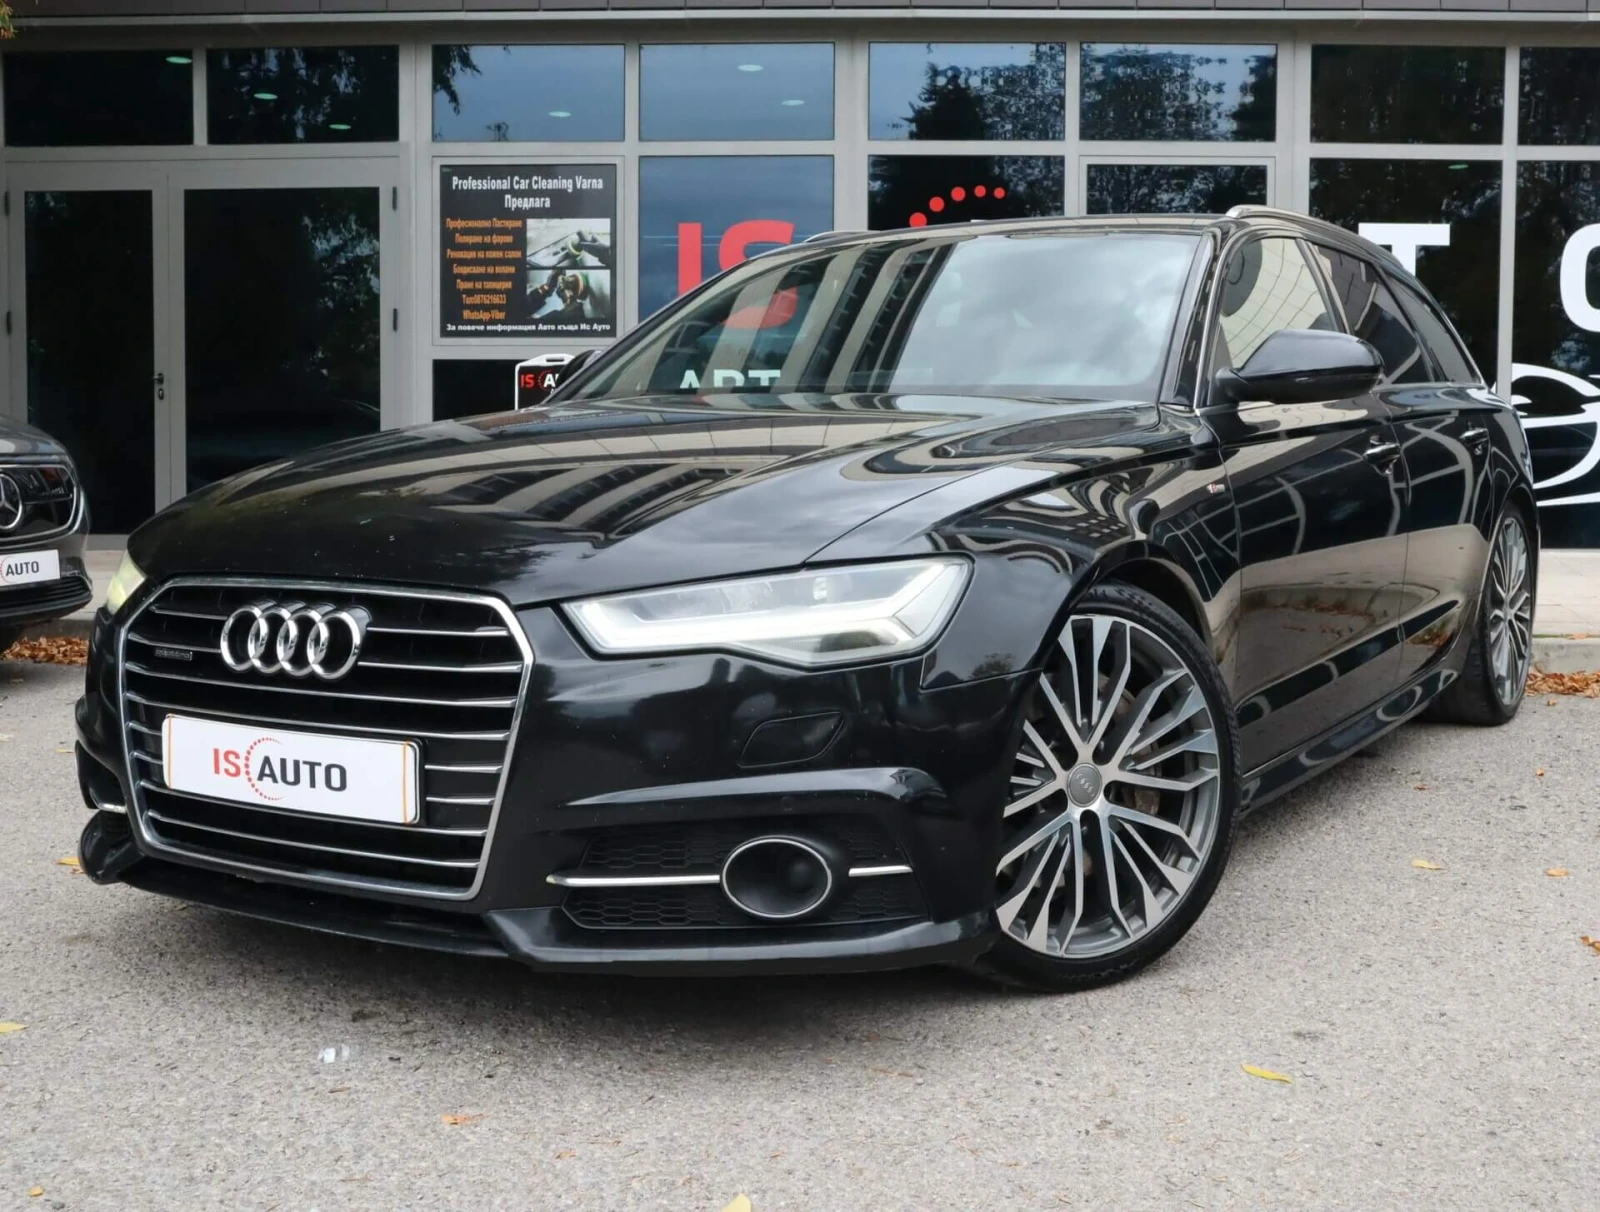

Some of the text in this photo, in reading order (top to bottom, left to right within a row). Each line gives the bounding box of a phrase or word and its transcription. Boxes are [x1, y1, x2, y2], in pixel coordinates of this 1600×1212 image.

[452, 175, 604, 192] Professional Car Cleaning Varna
[504, 194, 551, 211] Предлага
[483, 235, 491, 244] на
[477, 250, 485, 259] на
[486, 266, 494, 274] на
[474, 281, 482, 289] на
[446, 323, 456, 331] За
[486, 323, 536, 332] информация
[537, 323, 556, 331] Авто
[557, 324, 579, 332] къща
[580, 323, 590, 331] Ис
[592, 323, 611, 332] Ауто
[520, 373, 535, 389] IS
[5, 560, 40, 577] AUTO
[212, 747, 348, 793] IS AUTO
